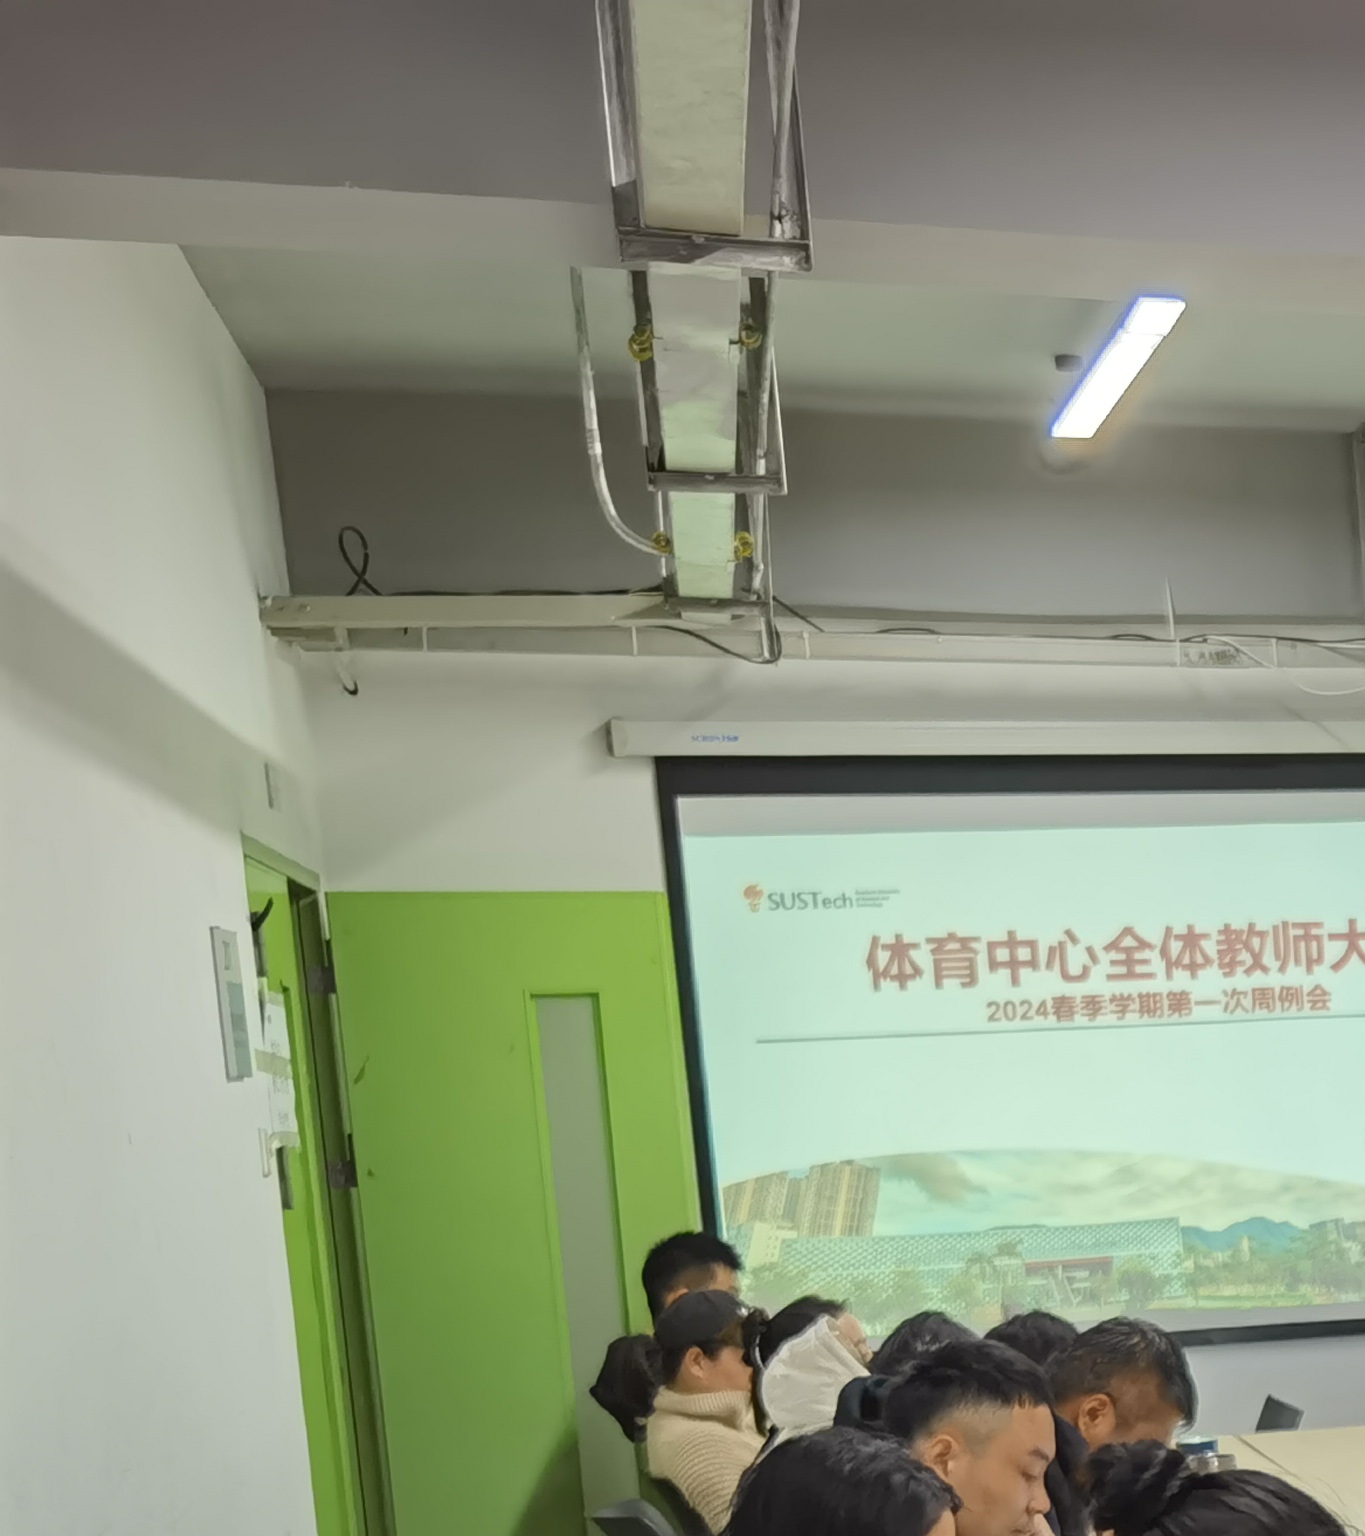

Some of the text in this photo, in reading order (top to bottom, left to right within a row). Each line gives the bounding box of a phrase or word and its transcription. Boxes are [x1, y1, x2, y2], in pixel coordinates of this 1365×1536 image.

[767, 892, 853, 911] SUSTech
[987, 984, 1332, 1023] 2024春季学期第一次周例会
